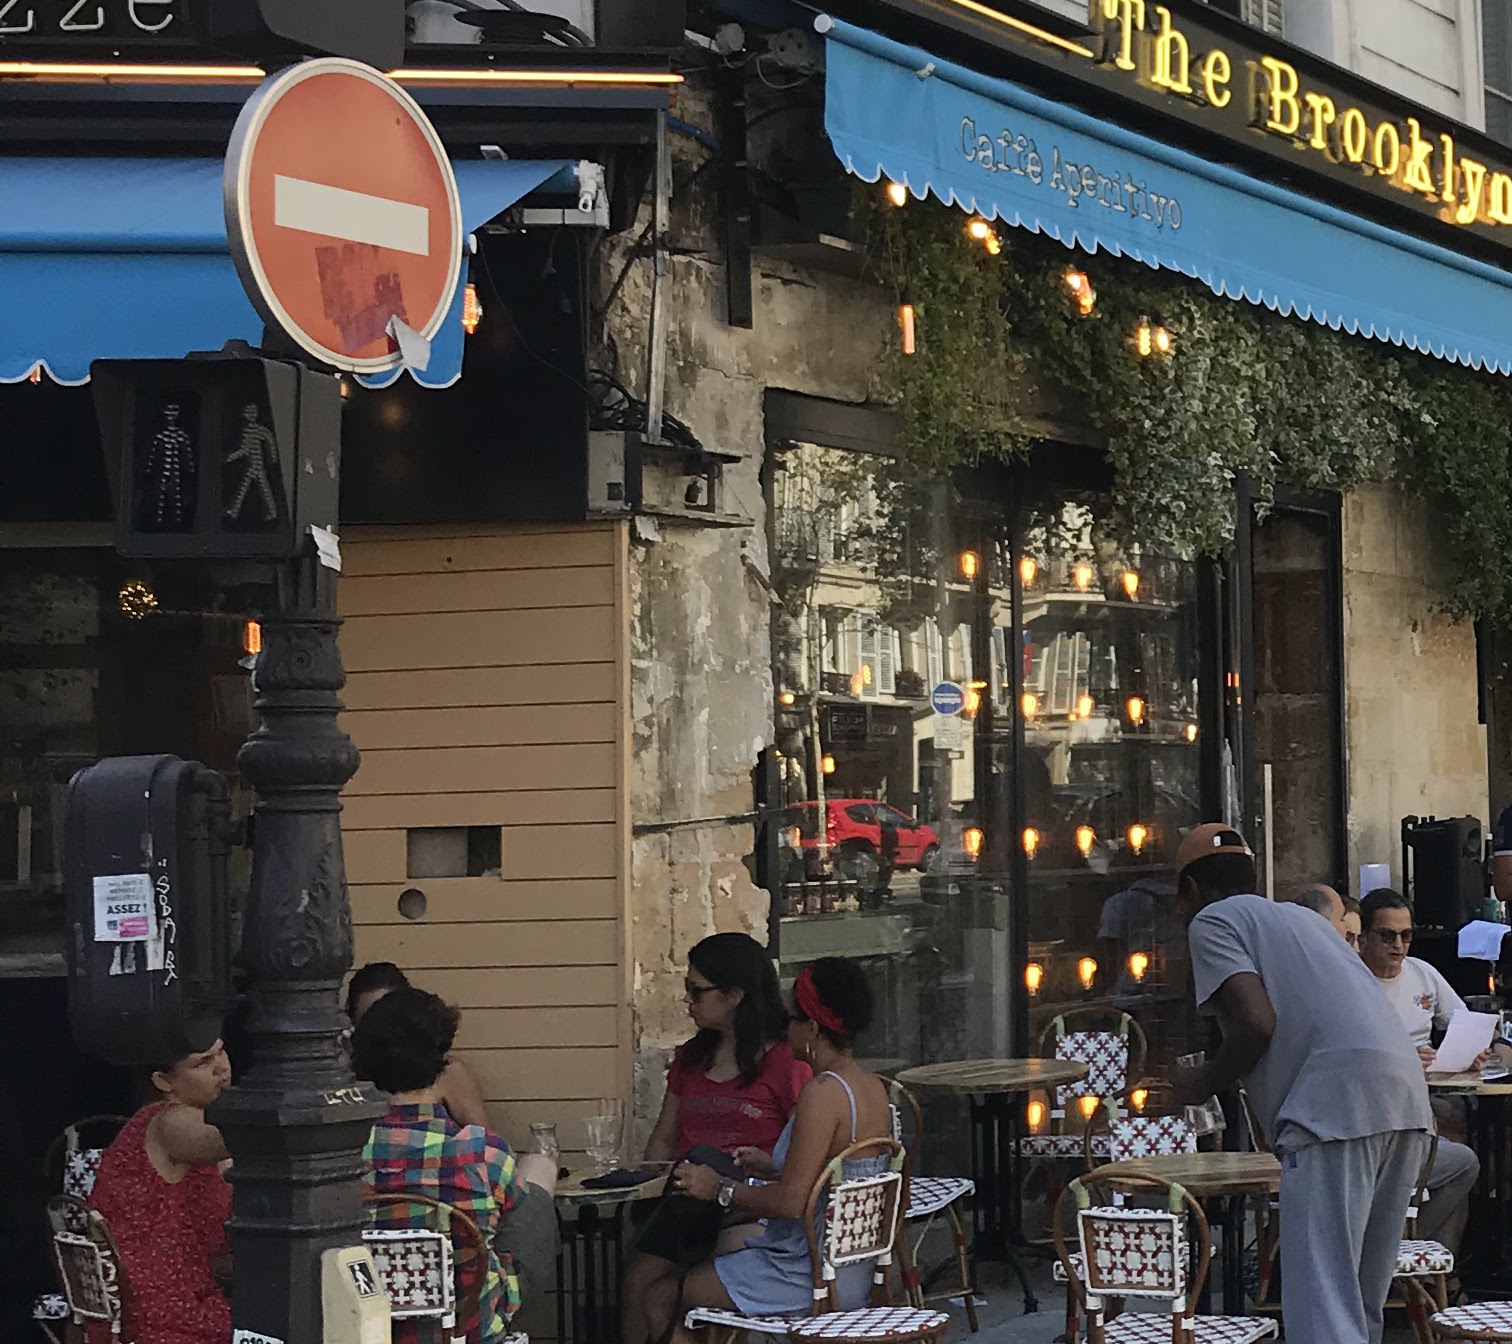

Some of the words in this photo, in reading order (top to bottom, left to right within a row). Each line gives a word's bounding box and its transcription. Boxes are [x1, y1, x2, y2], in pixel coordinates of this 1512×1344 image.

[960, 115, 1043, 185] Caffè
[1050, 145, 1182, 230] Aperitivo
[107, 903, 141, 915] ASSEZ
